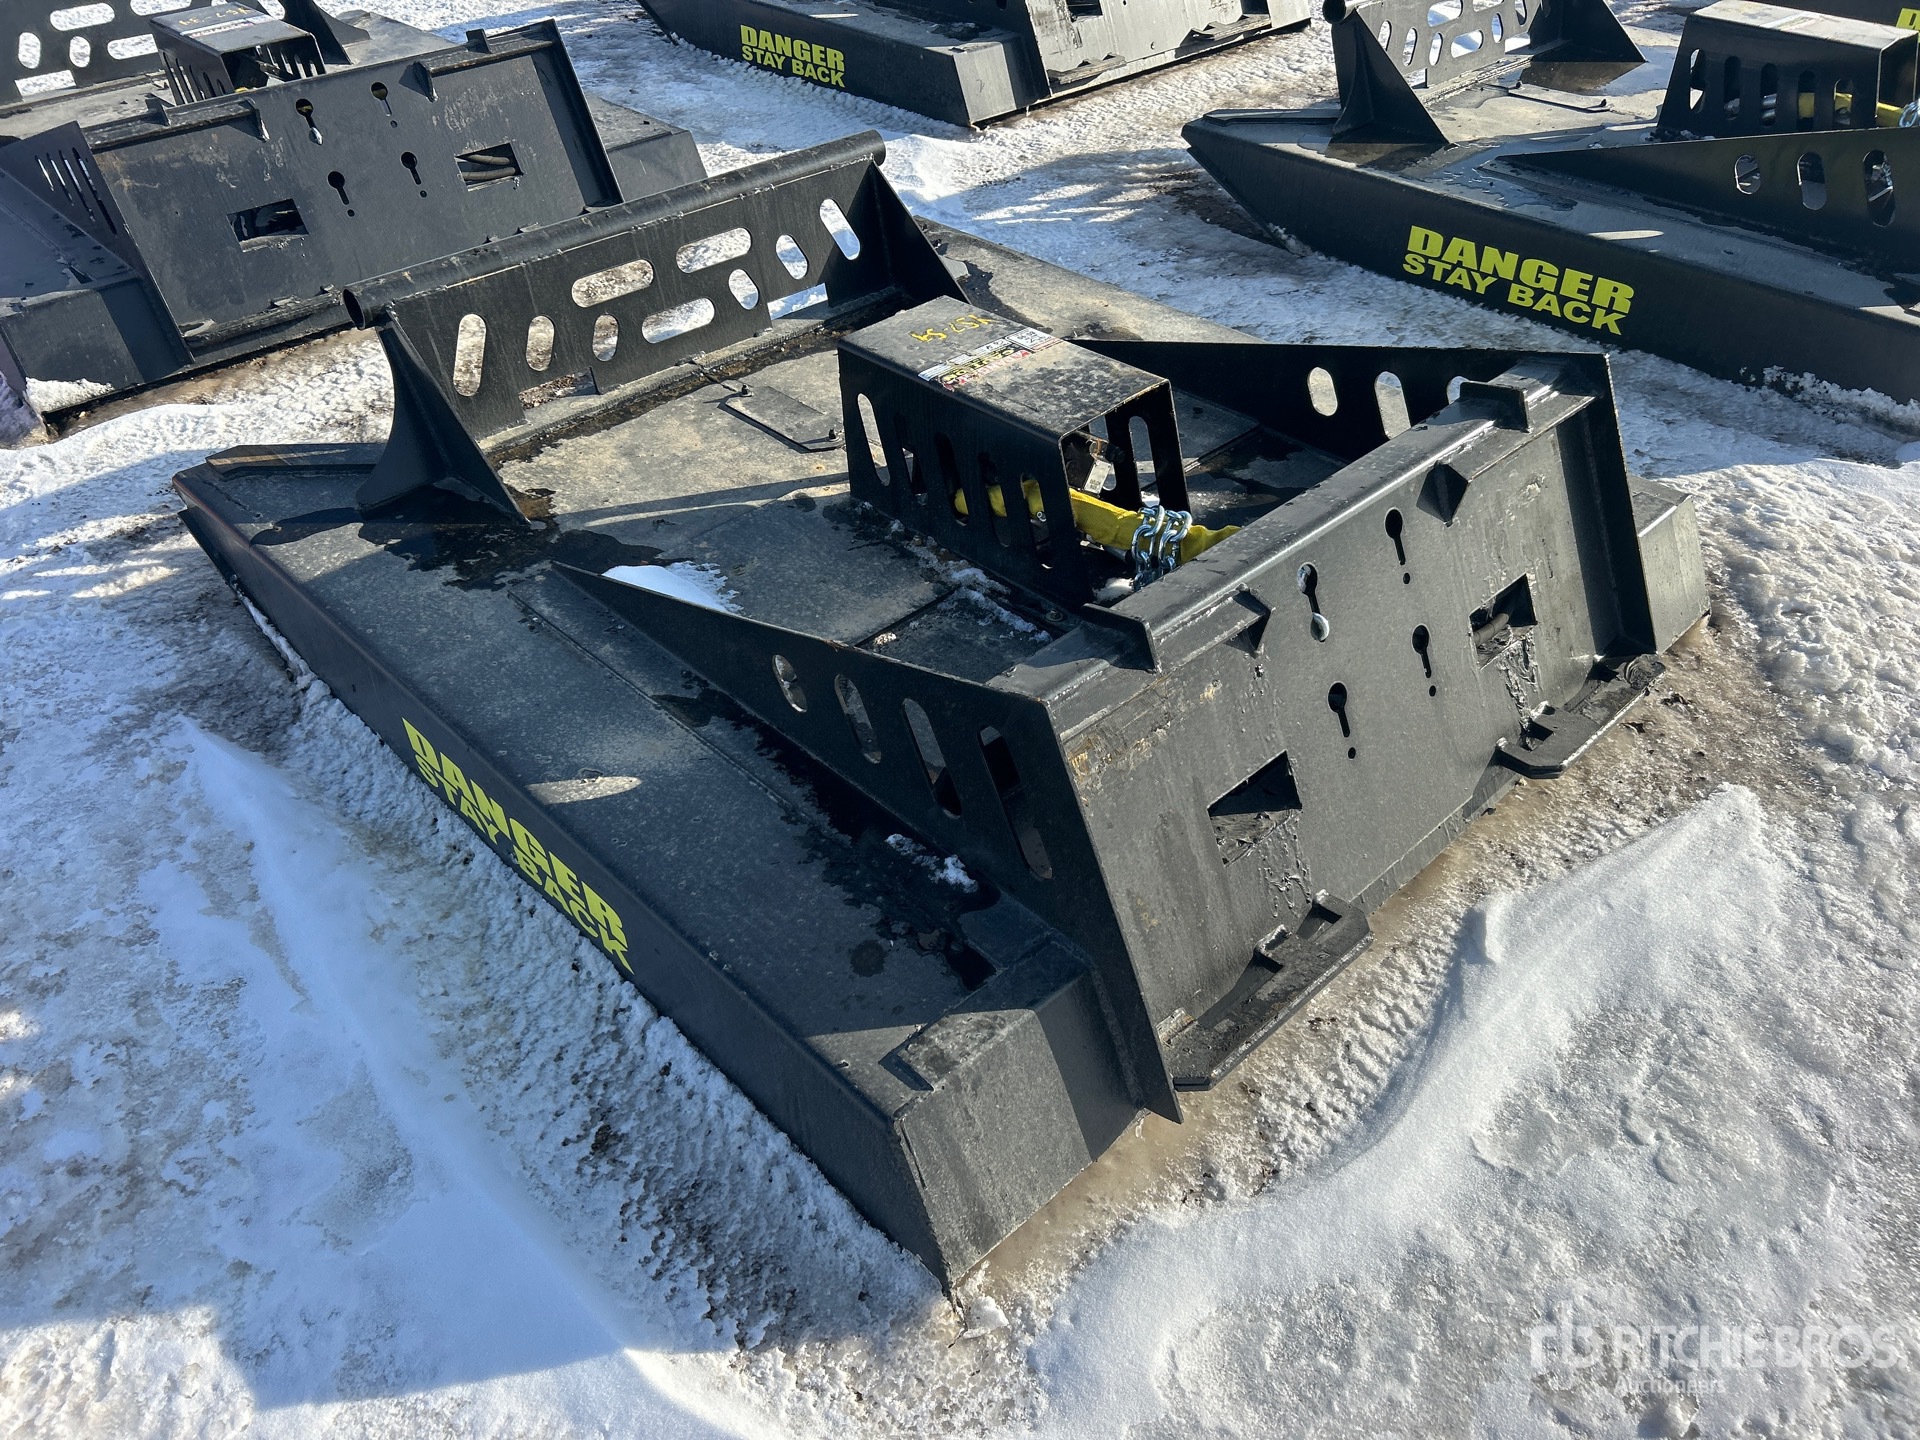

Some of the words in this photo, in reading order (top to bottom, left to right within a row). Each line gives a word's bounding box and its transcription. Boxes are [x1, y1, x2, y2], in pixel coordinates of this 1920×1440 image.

[741, 25, 845, 72] DANGER
[742, 45, 786, 70] STAY
[791, 59, 845, 88] BACK
[1402, 253, 1498, 294] STAY
[1507, 283, 1626, 336] BACK
[1407, 225, 1635, 314] DANGER
[402, 716, 629, 950] DANGER
[415, 754, 500, 845] STAY
[513, 844, 635, 976] BACK
